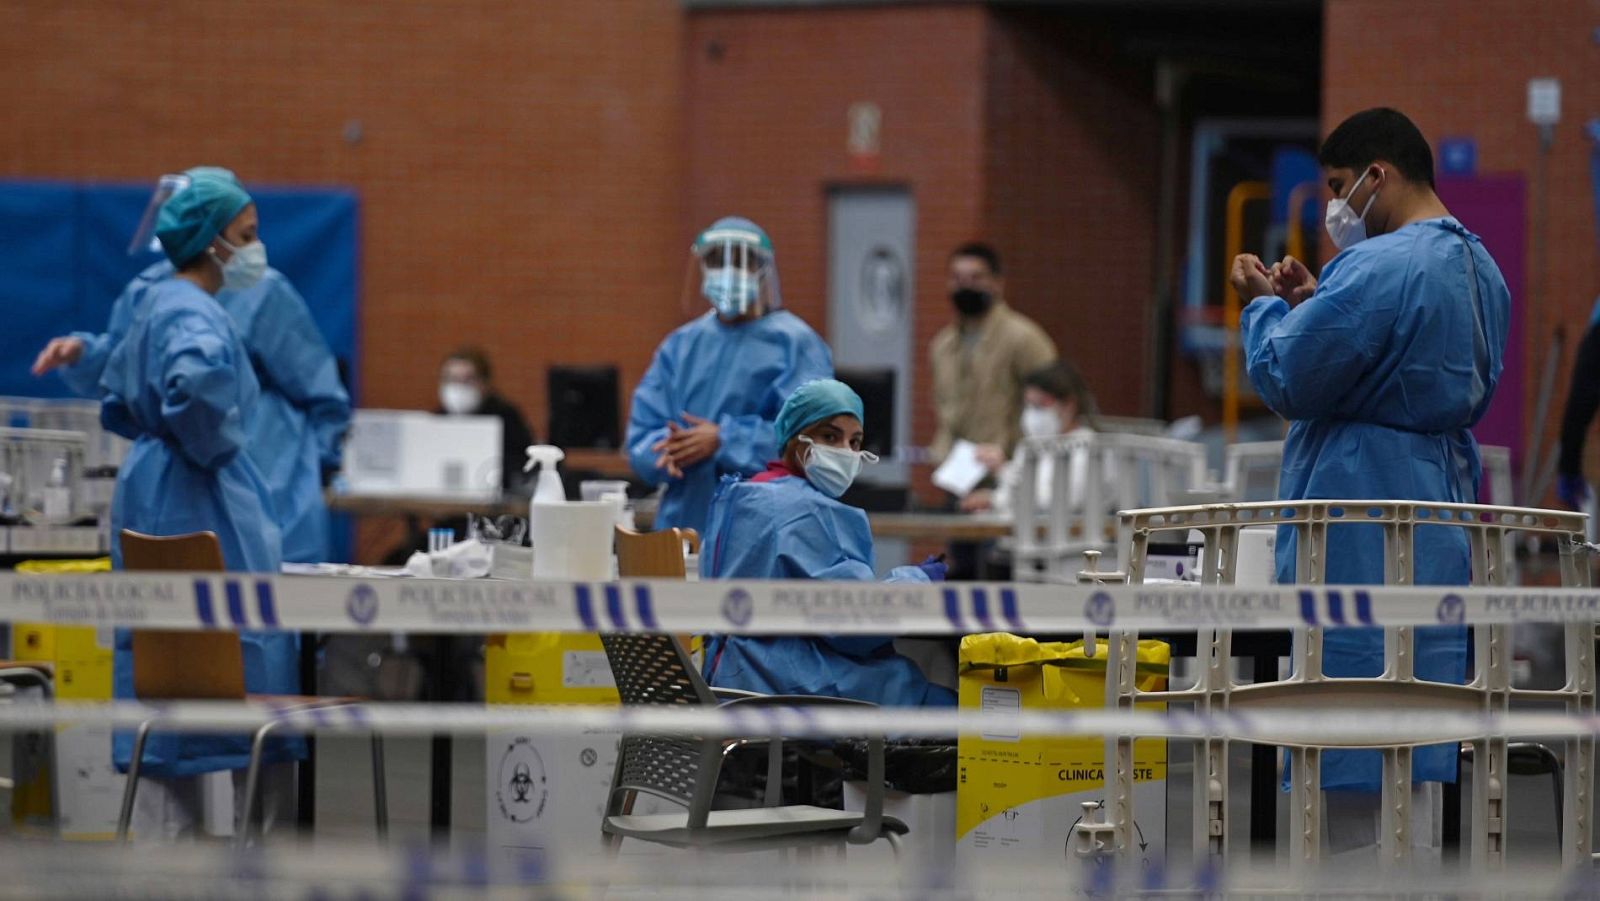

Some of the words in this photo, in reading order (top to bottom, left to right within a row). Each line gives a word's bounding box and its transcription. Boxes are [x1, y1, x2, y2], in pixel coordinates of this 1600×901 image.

[105, 582, 176, 602] LOCAL
[487, 586, 556, 605] LOCAL
[1217, 592, 1280, 611] LOCAL
[1058, 769, 1105, 780] CLINICA
